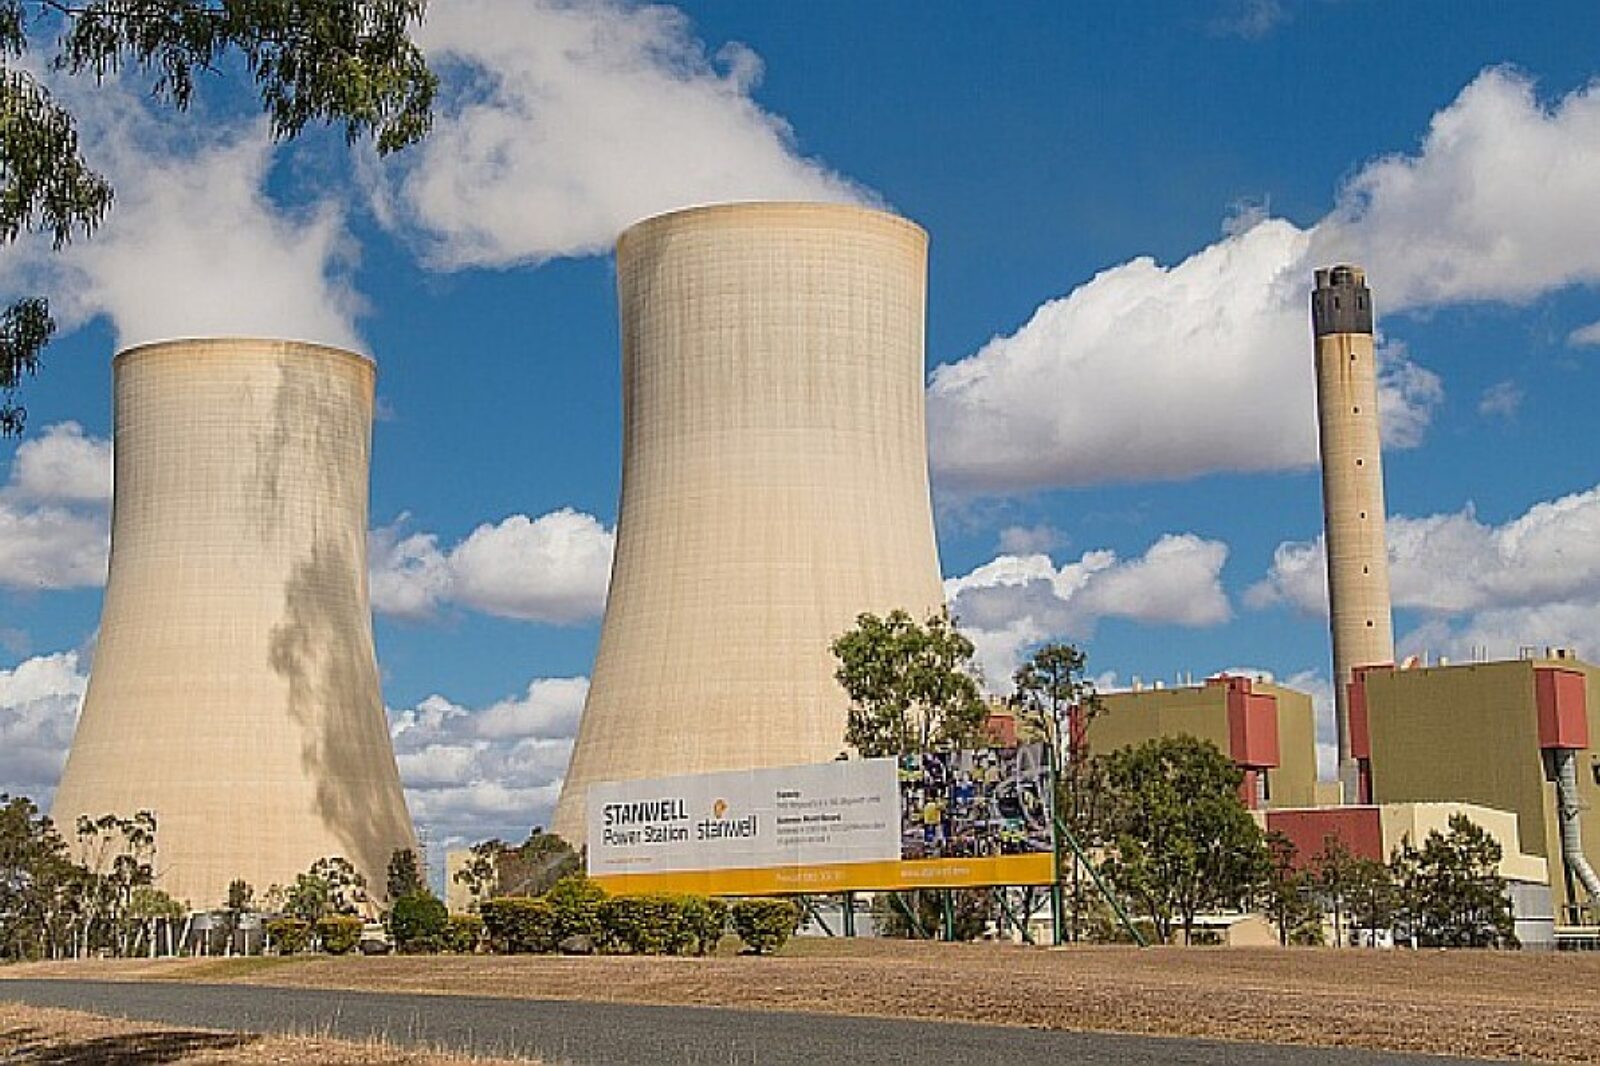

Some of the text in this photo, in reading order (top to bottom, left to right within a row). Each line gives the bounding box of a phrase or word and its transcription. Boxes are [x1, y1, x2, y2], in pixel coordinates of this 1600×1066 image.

[603, 800, 688, 825] STANWELL
[603, 824, 688, 846] Power Station
[698, 815, 757, 840] stanwell
